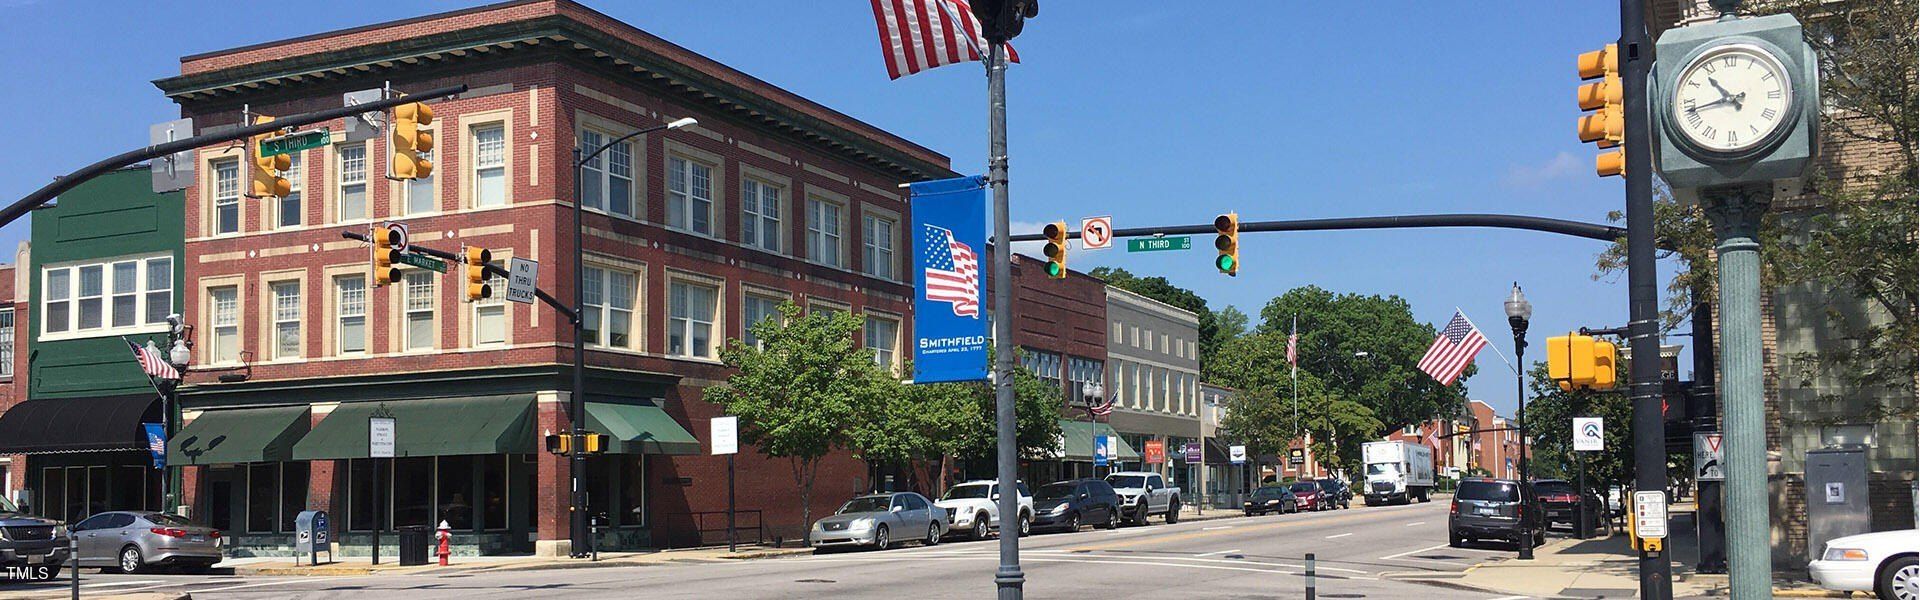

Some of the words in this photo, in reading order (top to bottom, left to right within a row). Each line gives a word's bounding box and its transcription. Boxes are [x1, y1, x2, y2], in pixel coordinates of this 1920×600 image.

[1724, 56, 1737, 68] XII
[1702, 61, 1716, 75] XI
[1762, 71, 1774, 82] II
[1688, 80, 1701, 89] X
[1767, 89, 1780, 99] III
[1702, 126, 1717, 140] VII
[1728, 130, 1738, 144] VI
[274, 141, 280, 152] S
[285, 135, 308, 150] THIRD
[1139, 240, 1145, 249] N
[1148, 240, 1170, 249] THIRD
[413, 256, 436, 269] MARKET
[520, 263, 530, 272] NO
[515, 275, 532, 286] THRU
[509, 287, 534, 300] TRUCKS
[920, 335, 985, 349] SMITHFIELD
[1698, 450, 1713, 459] HERE
[1711, 469, 1719, 477] TO
